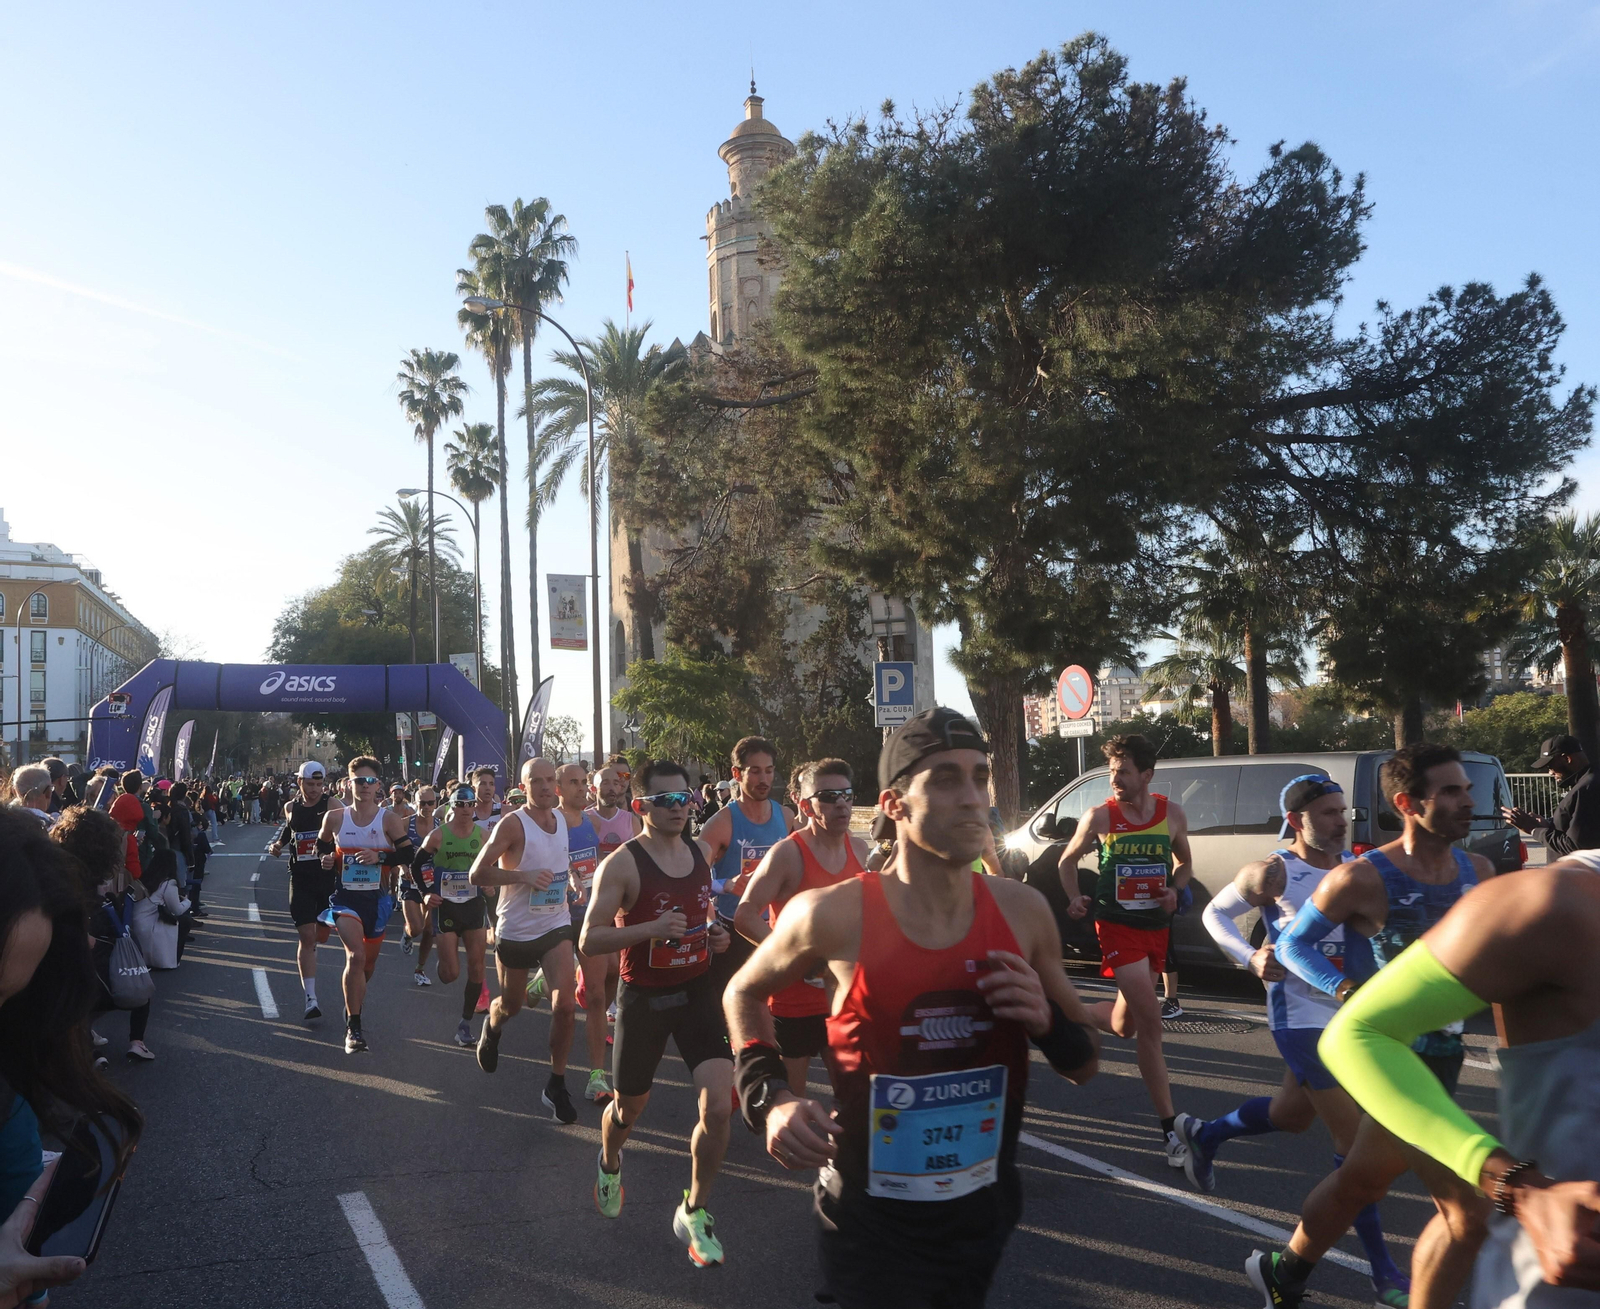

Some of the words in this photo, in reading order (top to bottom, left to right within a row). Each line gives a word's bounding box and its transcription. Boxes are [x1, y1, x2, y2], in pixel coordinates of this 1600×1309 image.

[332, 696, 347, 704] body
[574, 850, 593, 860] ZURICH
[1135, 867, 1161, 876] ZURICH
[553, 874, 567, 882] URICH
[922, 1079, 991, 1102] ZURICH
[922, 1124, 964, 1146] 3747
[924, 1152, 963, 1171] ABEL
